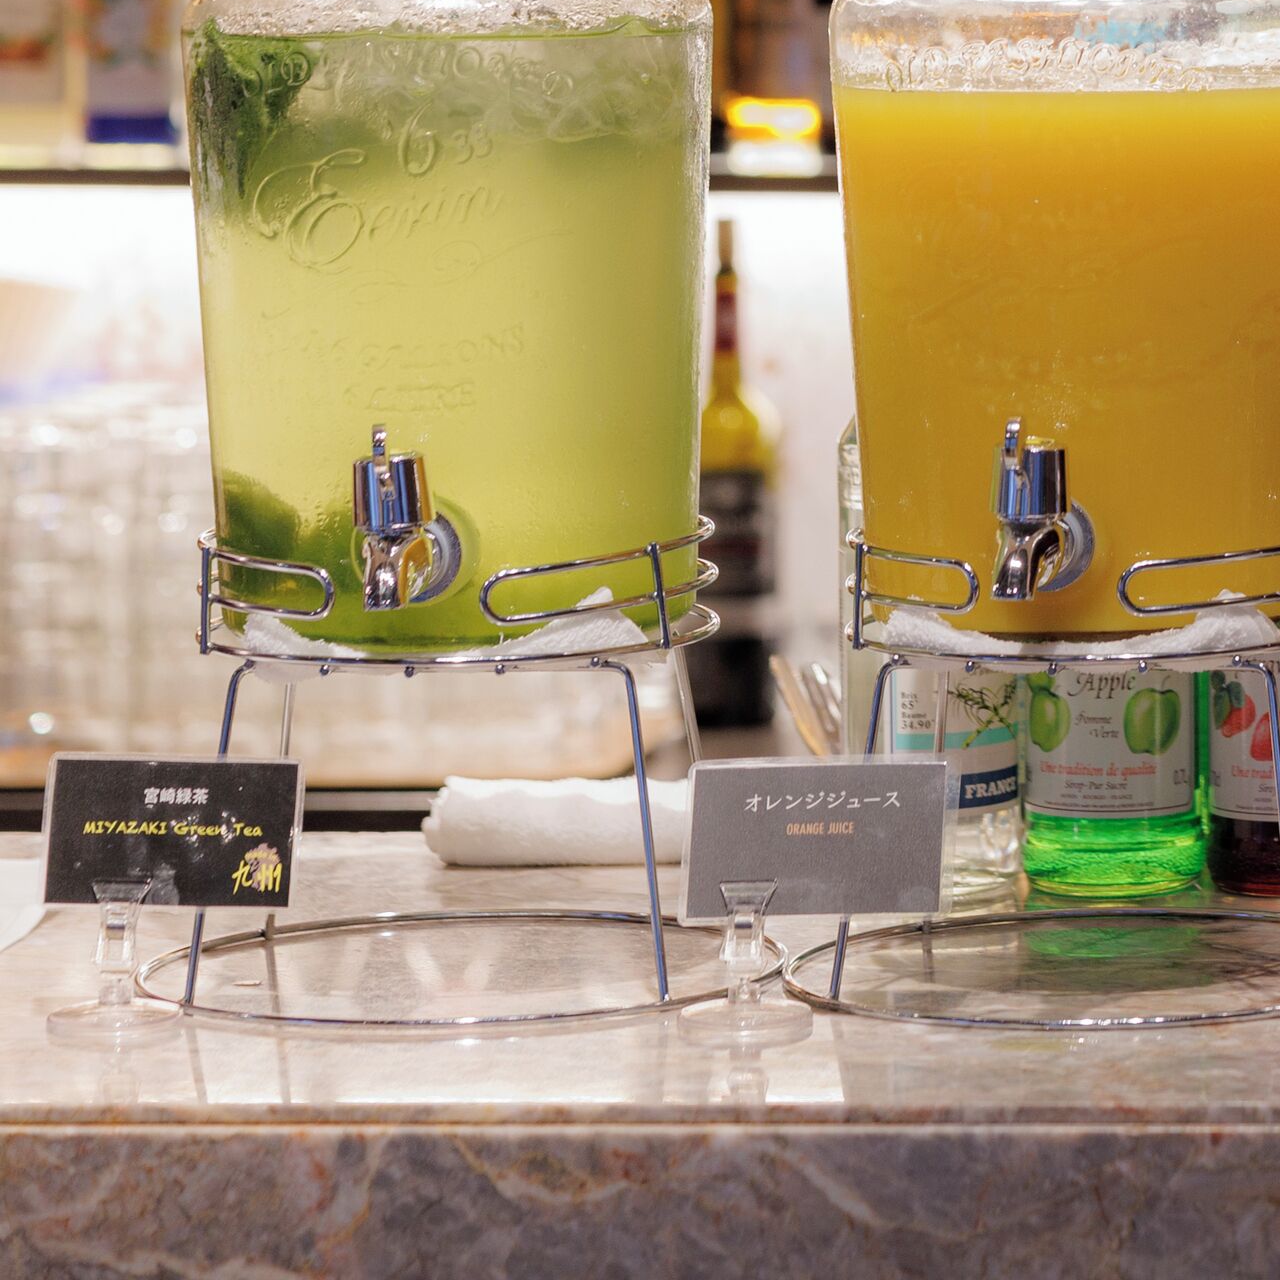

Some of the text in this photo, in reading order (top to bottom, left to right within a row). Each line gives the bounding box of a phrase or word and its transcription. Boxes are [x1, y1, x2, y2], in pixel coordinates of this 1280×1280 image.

[1067, 672, 1136, 699] Apple
[144, 787, 209, 805] 宮崎緑茶
[744, 790, 900, 813] オレンジジュース
[83, 821, 262, 837] MIYAZAKI Green Tea
[786, 822, 855, 835] ORANGE JUICE
